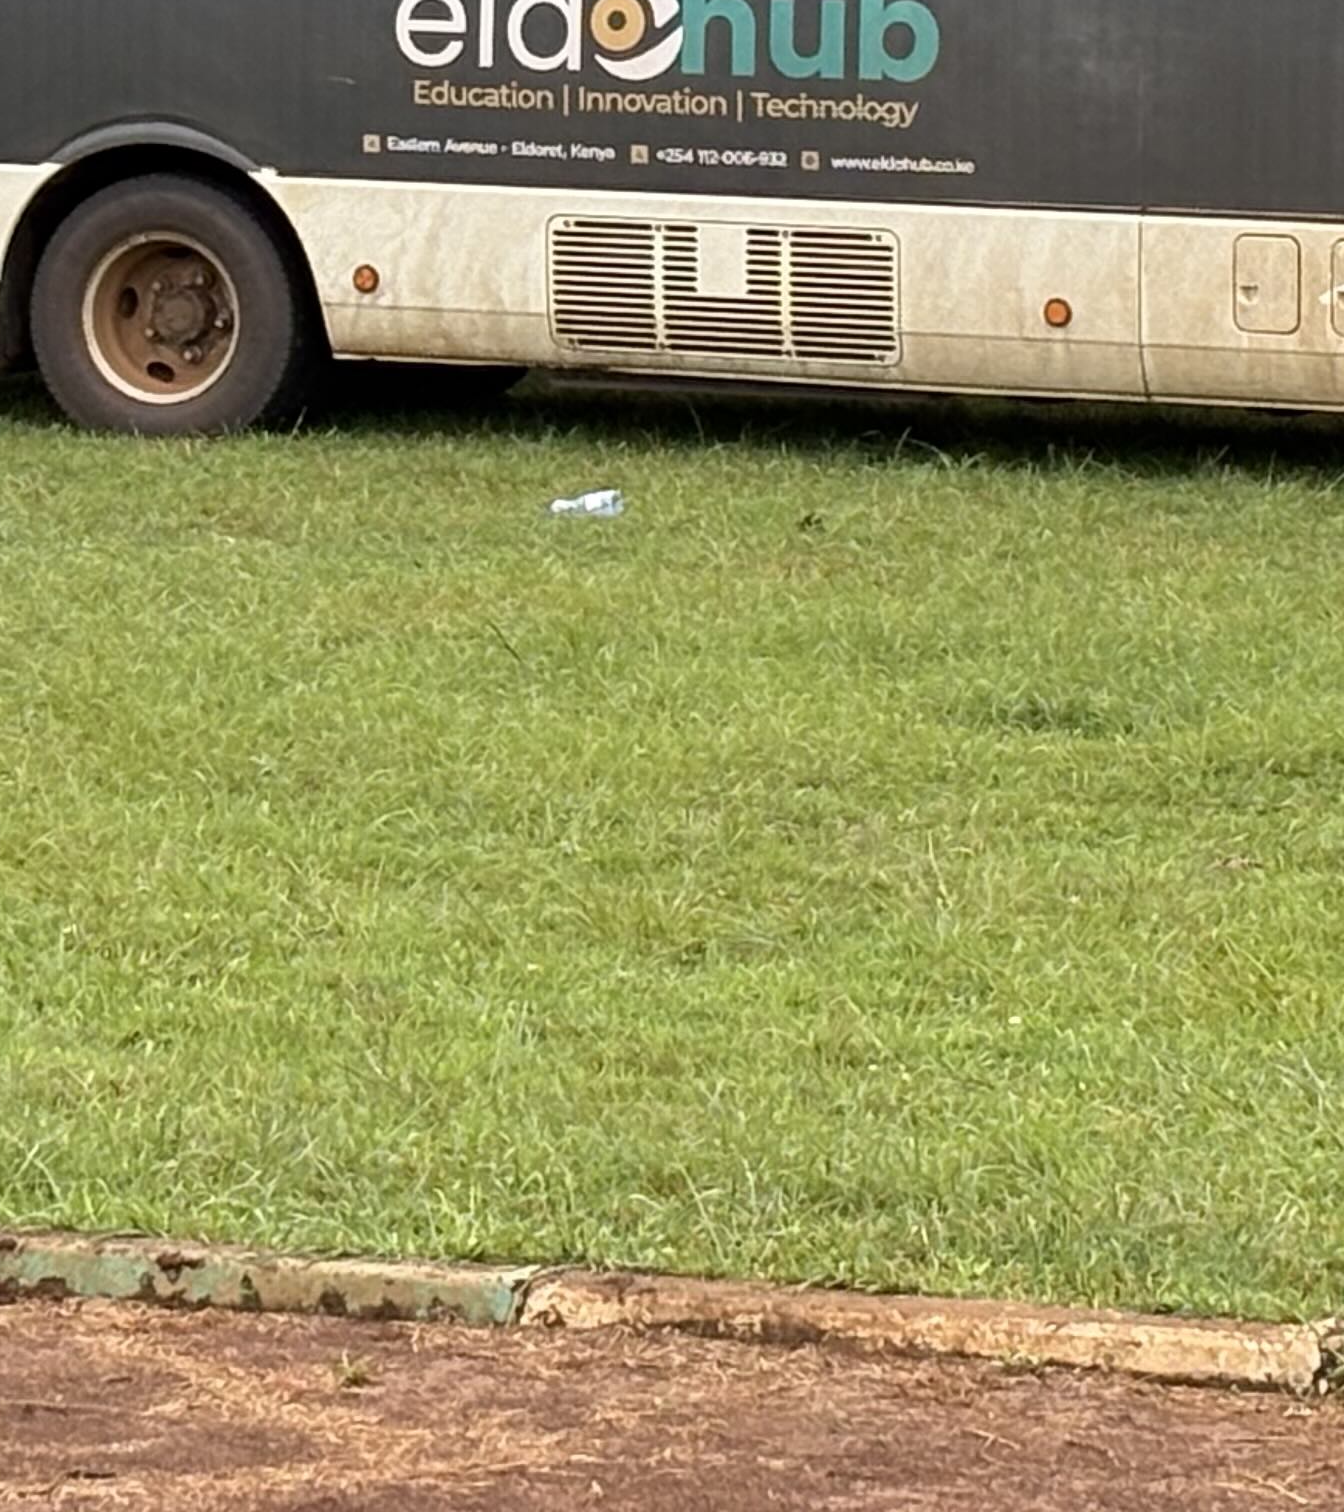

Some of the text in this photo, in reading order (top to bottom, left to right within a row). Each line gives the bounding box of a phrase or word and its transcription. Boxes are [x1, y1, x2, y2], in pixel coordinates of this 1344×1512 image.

[413, 80, 554, 109] Education
[578, 85, 728, 116] Innovation
[750, 91, 919, 129] Technology
[387, 135, 441, 152] Eastern
[444, 138, 498, 154] Avenue
[570, 143, 616, 163] Kenya
